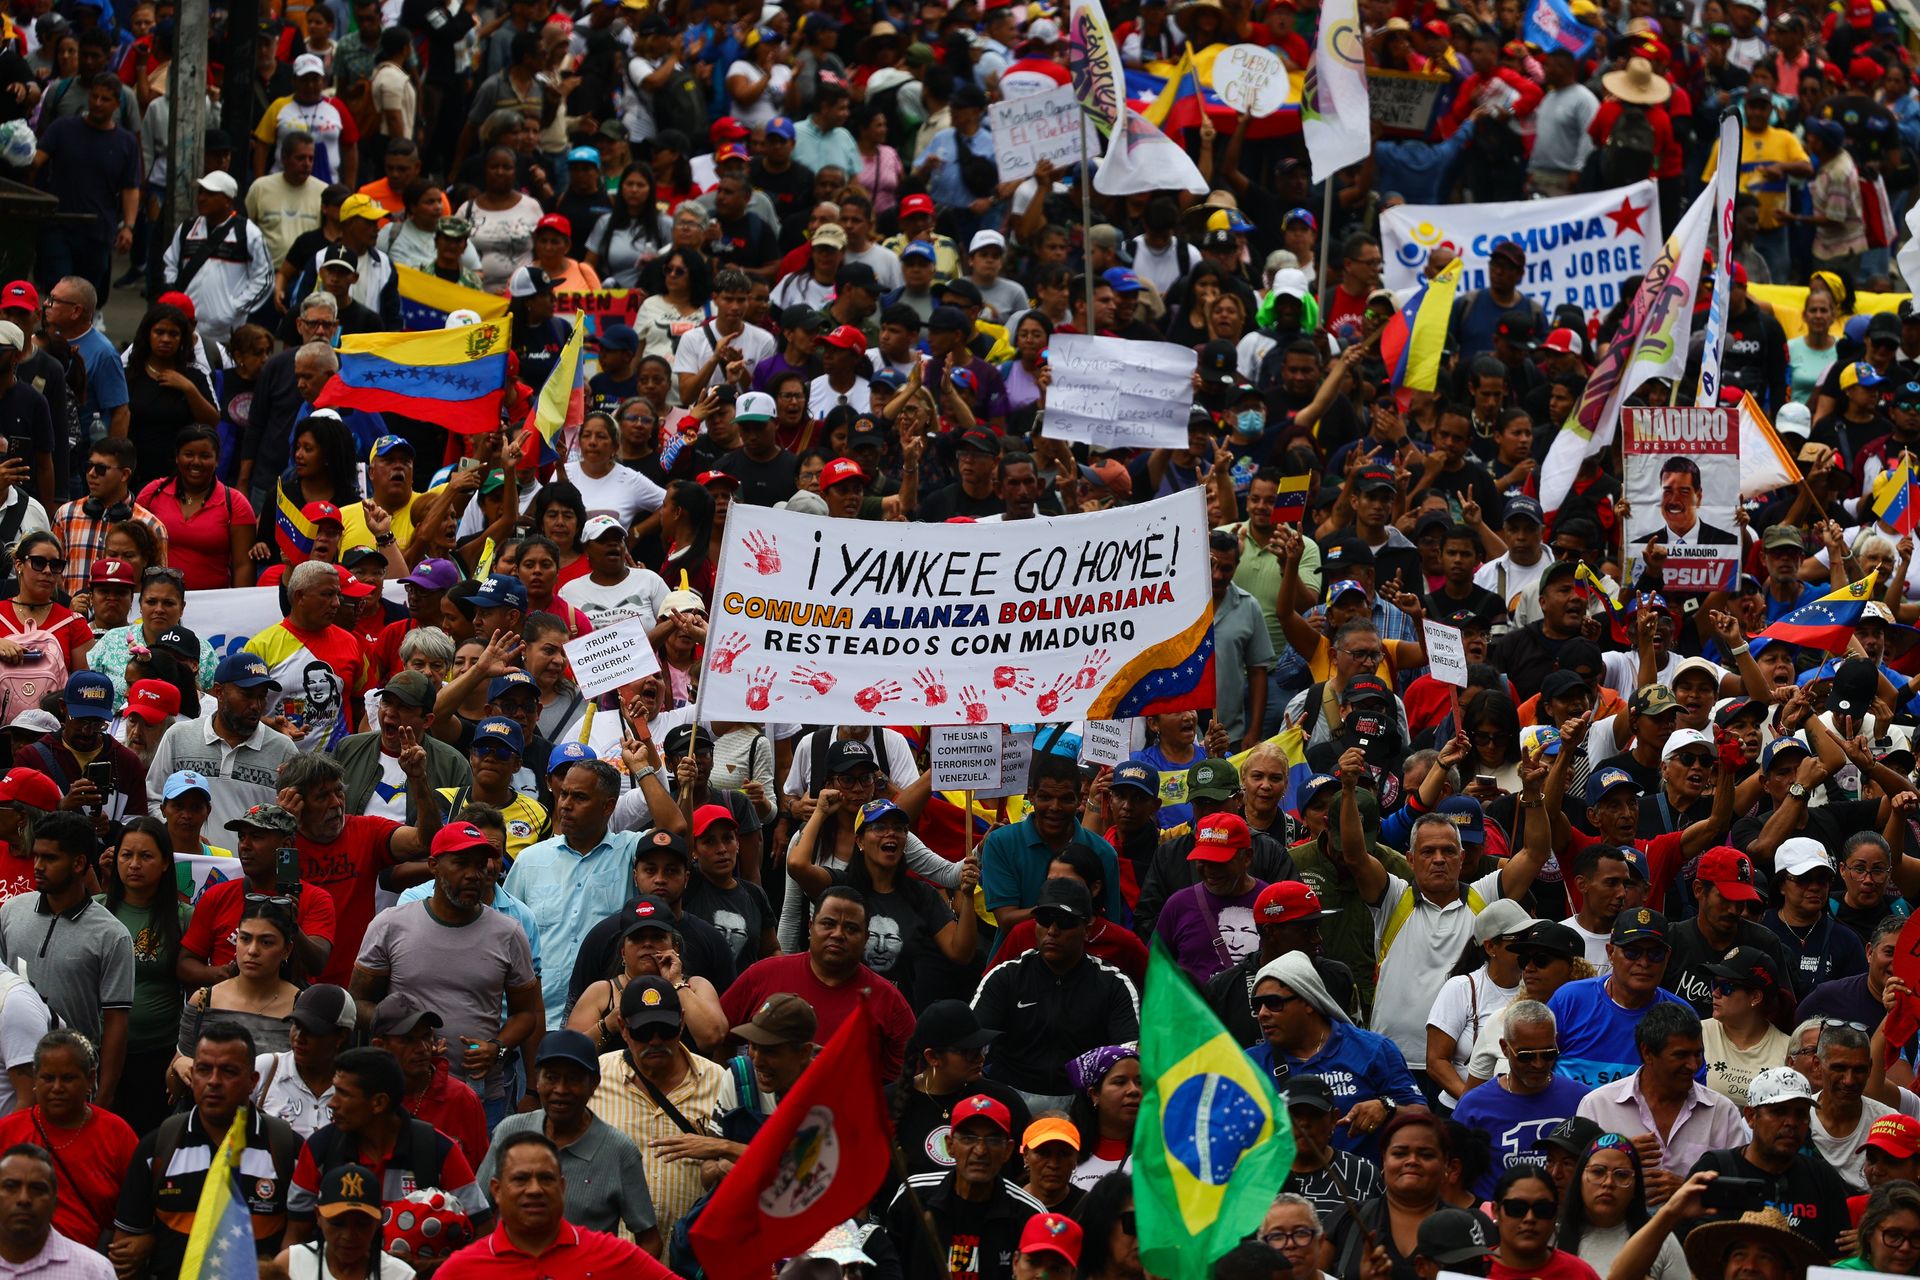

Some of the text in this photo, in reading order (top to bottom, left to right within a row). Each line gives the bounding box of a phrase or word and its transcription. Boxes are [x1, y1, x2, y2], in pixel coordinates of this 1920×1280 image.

[1472, 216, 1606, 257] COMUNA
[1565, 245, 1642, 279] JORGE
[1054, 418, 1073, 432] Se
[1632, 408, 1728, 442] MADURO
[1634, 442, 1727, 451] PRESIDENTE
[1014, 546, 1067, 593] GO
[1072, 525, 1180, 588] HOME!
[1684, 548, 1718, 558] MADURO
[1663, 562, 1725, 586] PSUV
[723, 581, 1175, 630] COMUNA ALIANZA BOLIVARIANA
[588, 608, 641, 621] URBERRY
[161, 631, 181, 642] alo
[764, 619, 1135, 656] RESTEADOS CON MADURO
[1424, 626, 1458, 641] NO TO TRUMP
[577, 638, 636, 666] CRIMINAL DE
[1433, 642, 1445, 651] WAR
[591, 654, 631, 674] GUERRA!
[942, 732, 988, 741] THE USA IS
[1091, 735, 1119, 749] EXIGIMOS
[937, 745, 992, 755] COMMITTING
[933, 758, 996, 769] TERRORISM ON
[1002, 764, 1017, 772] OLOR
[939, 772, 990, 783] VENEZUELA.
[1316, 1070, 1353, 1086] hite
[1597, 1071, 1636, 1084] SA
[1719, 1071, 1753, 1085] Mothe
[340, 1172, 363, 1199] NY
